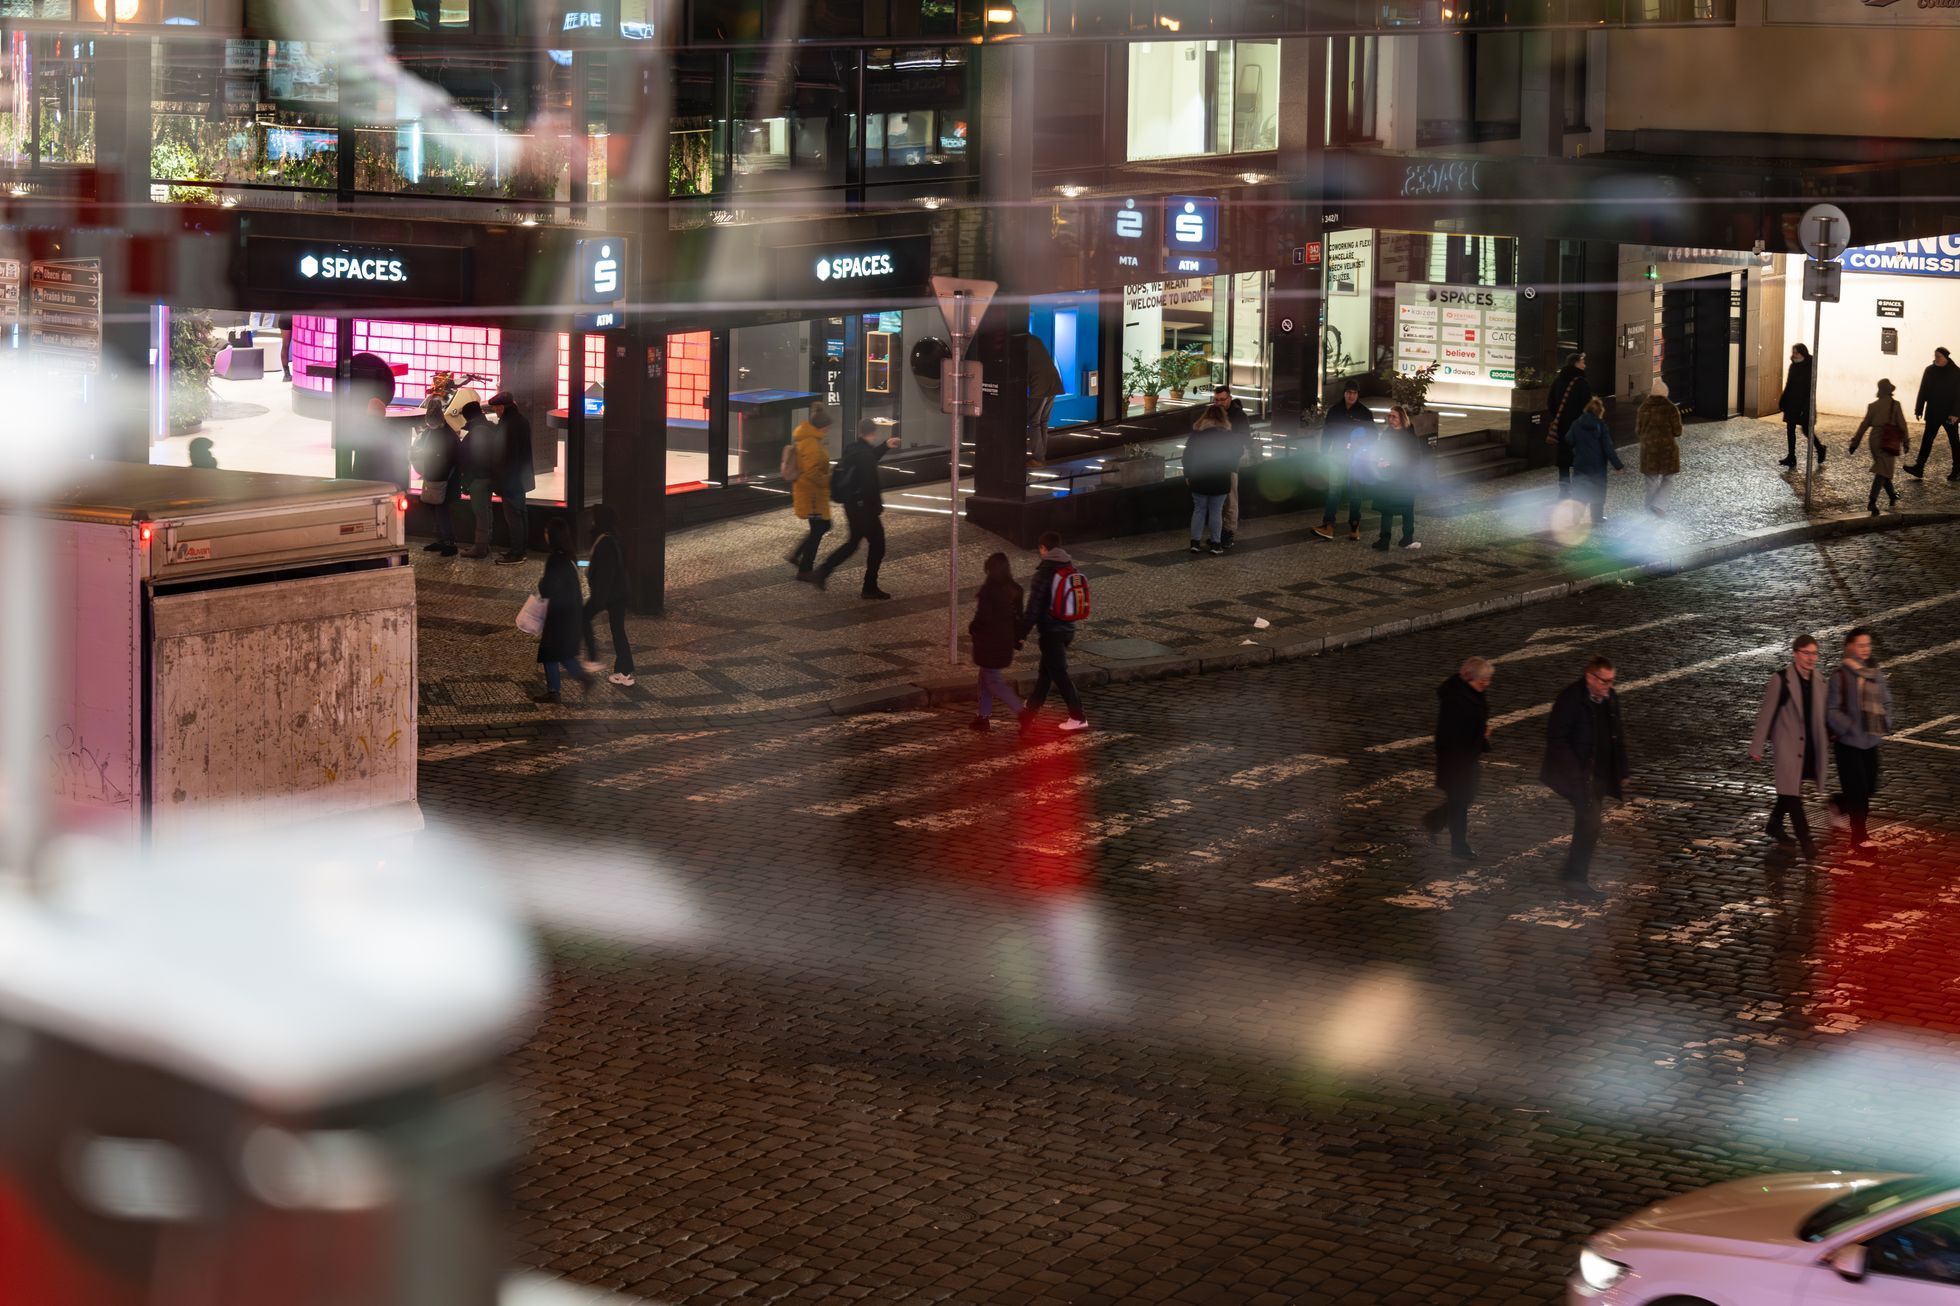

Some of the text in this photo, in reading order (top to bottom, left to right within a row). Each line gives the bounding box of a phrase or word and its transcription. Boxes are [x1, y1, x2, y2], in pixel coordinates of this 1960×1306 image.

[321, 257, 408, 282] SPACES.
[832, 254, 894, 280] SPACES.
[1178, 260, 1200, 272] ATM
[1151, 281, 1163, 293] WE
[1164, 278, 1189, 291] MEANT
[1169, 293, 1179, 305] TO
[1440, 291, 1497, 306] SPACES.
[596, 313, 614, 327] ATM
[1445, 348, 1476, 359] believe
